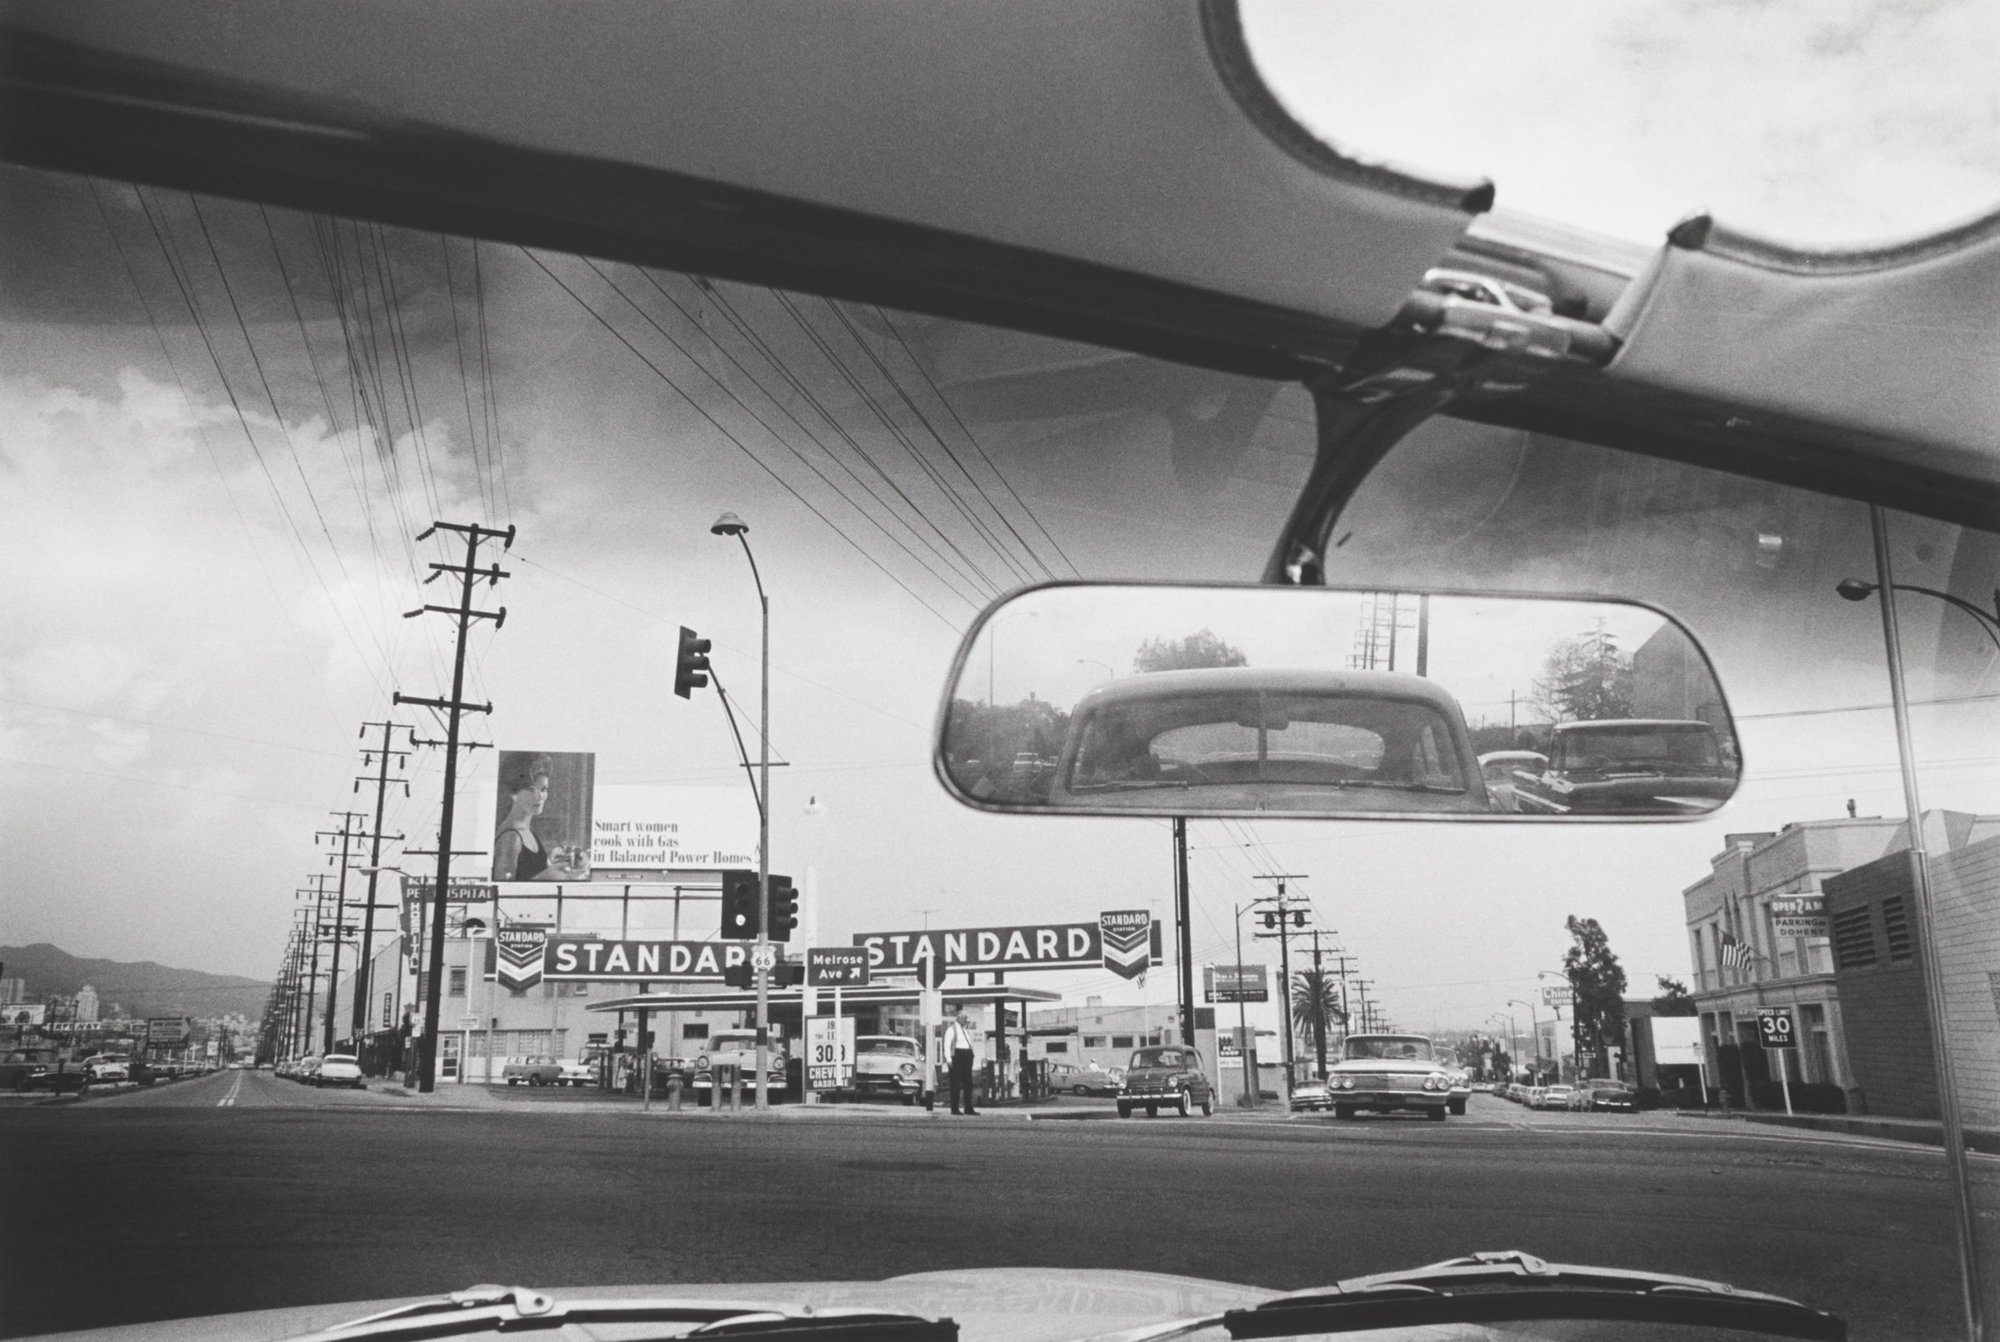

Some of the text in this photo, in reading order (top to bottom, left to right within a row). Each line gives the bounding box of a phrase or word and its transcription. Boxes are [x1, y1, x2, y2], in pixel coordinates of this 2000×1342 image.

[595, 821, 679, 832] Smart women
[594, 835, 679, 847] cook with Gas
[594, 850, 605, 863] in
[610, 850, 666, 863] Balanced
[670, 851, 708, 863] Power
[714, 851, 752, 864] Homes
[1101, 914, 1148, 927] STANDARD
[1776, 919, 1818, 927] PARKING
[499, 932, 545, 943] STANDARD
[865, 928, 1090, 966] STANDARD
[755, 957, 771, 966] 66
[813, 954, 863, 965] Melrose
[819, 969, 842, 980] Ave
[1758, 1008, 1774, 1016] SPEED
[1775, 1008, 1790, 1016] LIMIT
[1762, 1016, 1790, 1034] 30
[1768, 1034, 1788, 1042] MILES
